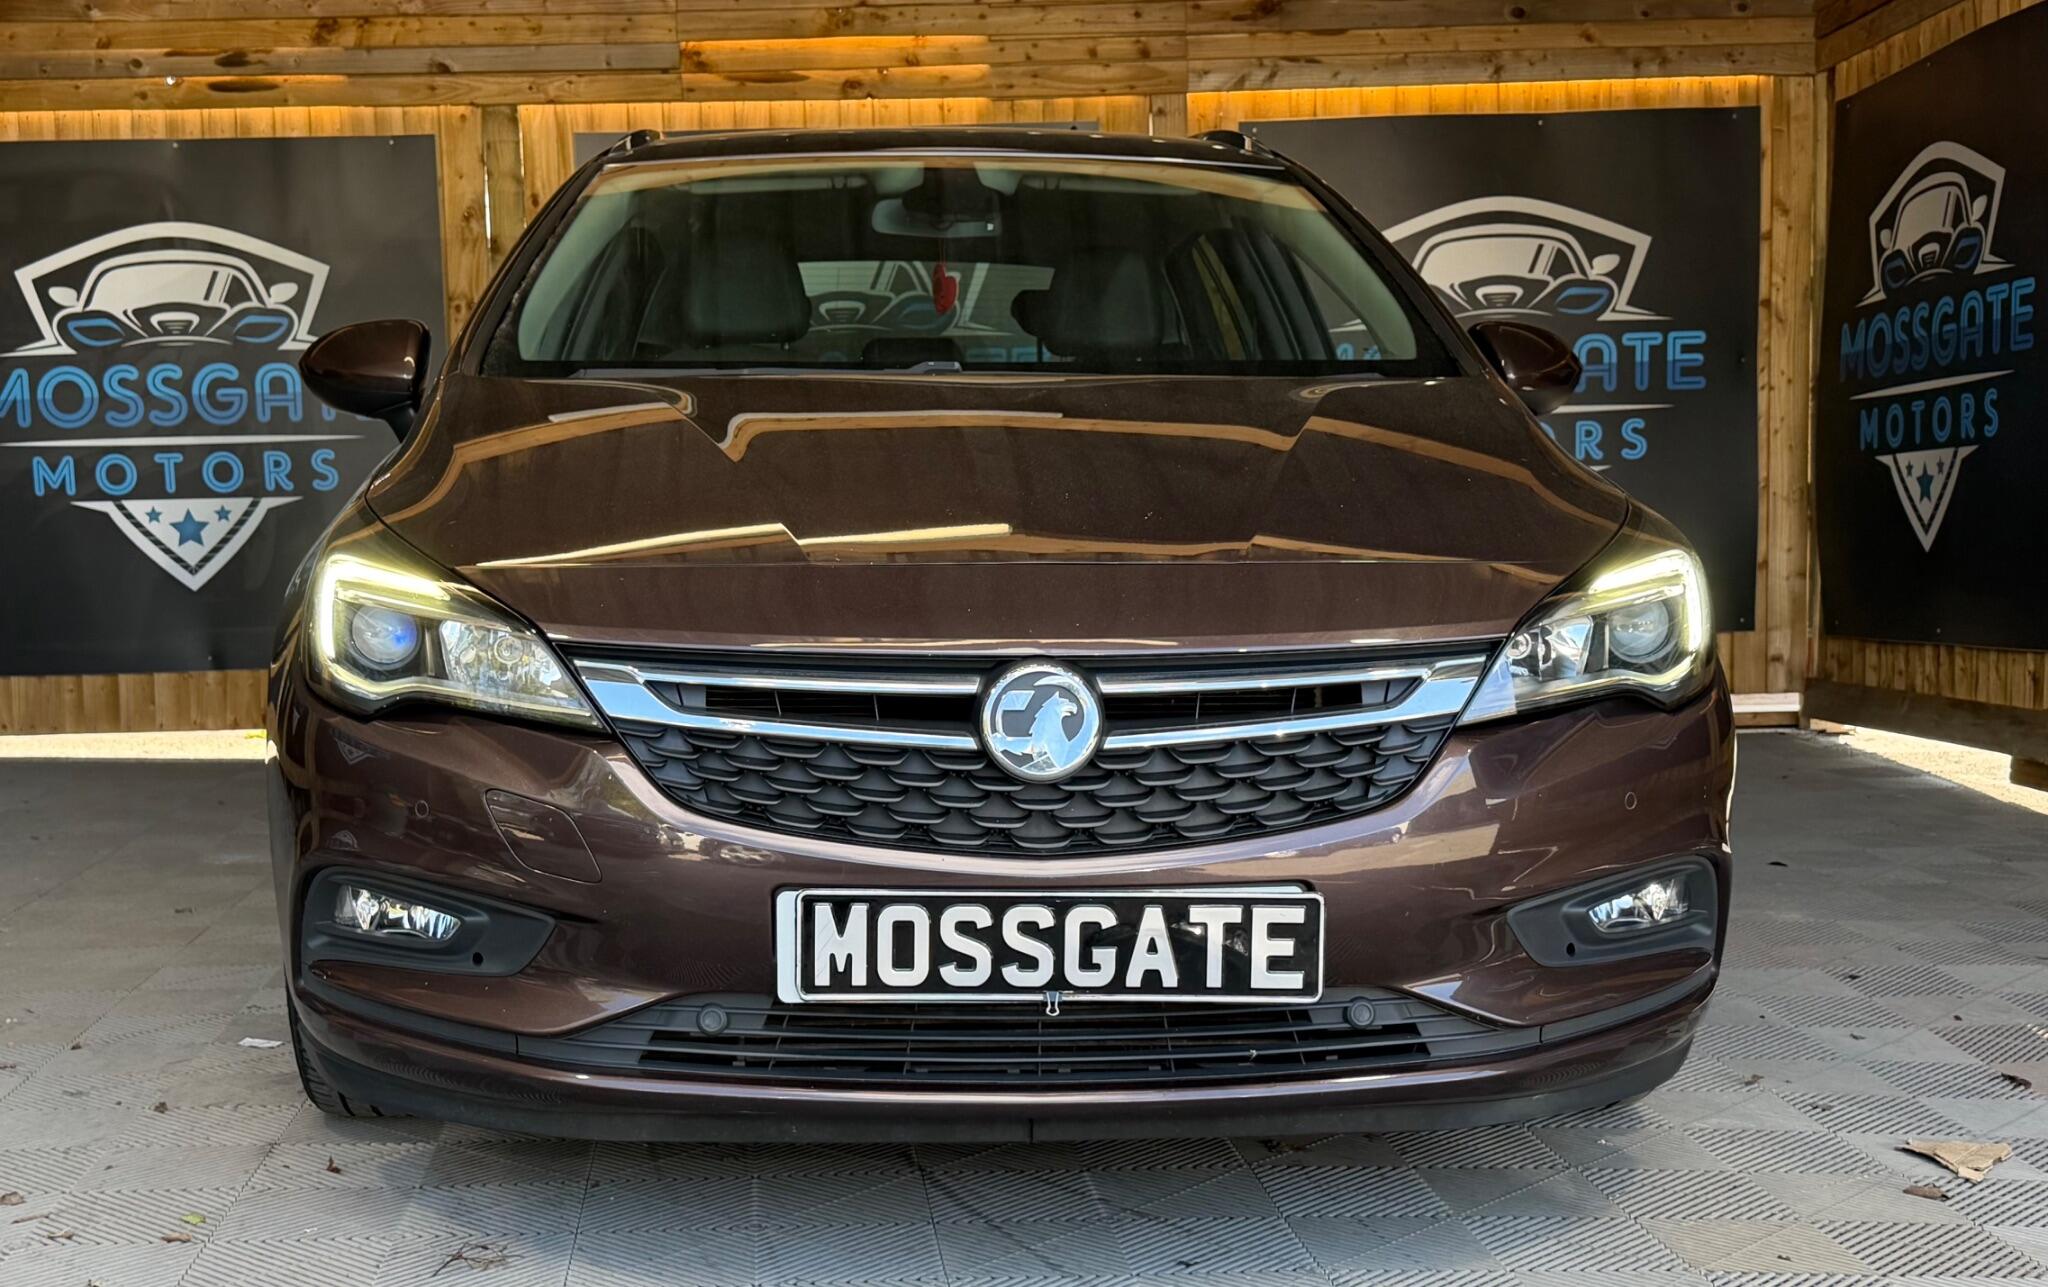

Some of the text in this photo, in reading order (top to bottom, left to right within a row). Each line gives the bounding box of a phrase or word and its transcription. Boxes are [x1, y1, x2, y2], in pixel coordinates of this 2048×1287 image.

[1839, 276, 2036, 383] MOSSGATE
[1859, 387, 1999, 450] MOTORS
[32, 448, 340, 496] MOTORS
[813, 902, 1305, 989] MOSSGATE
